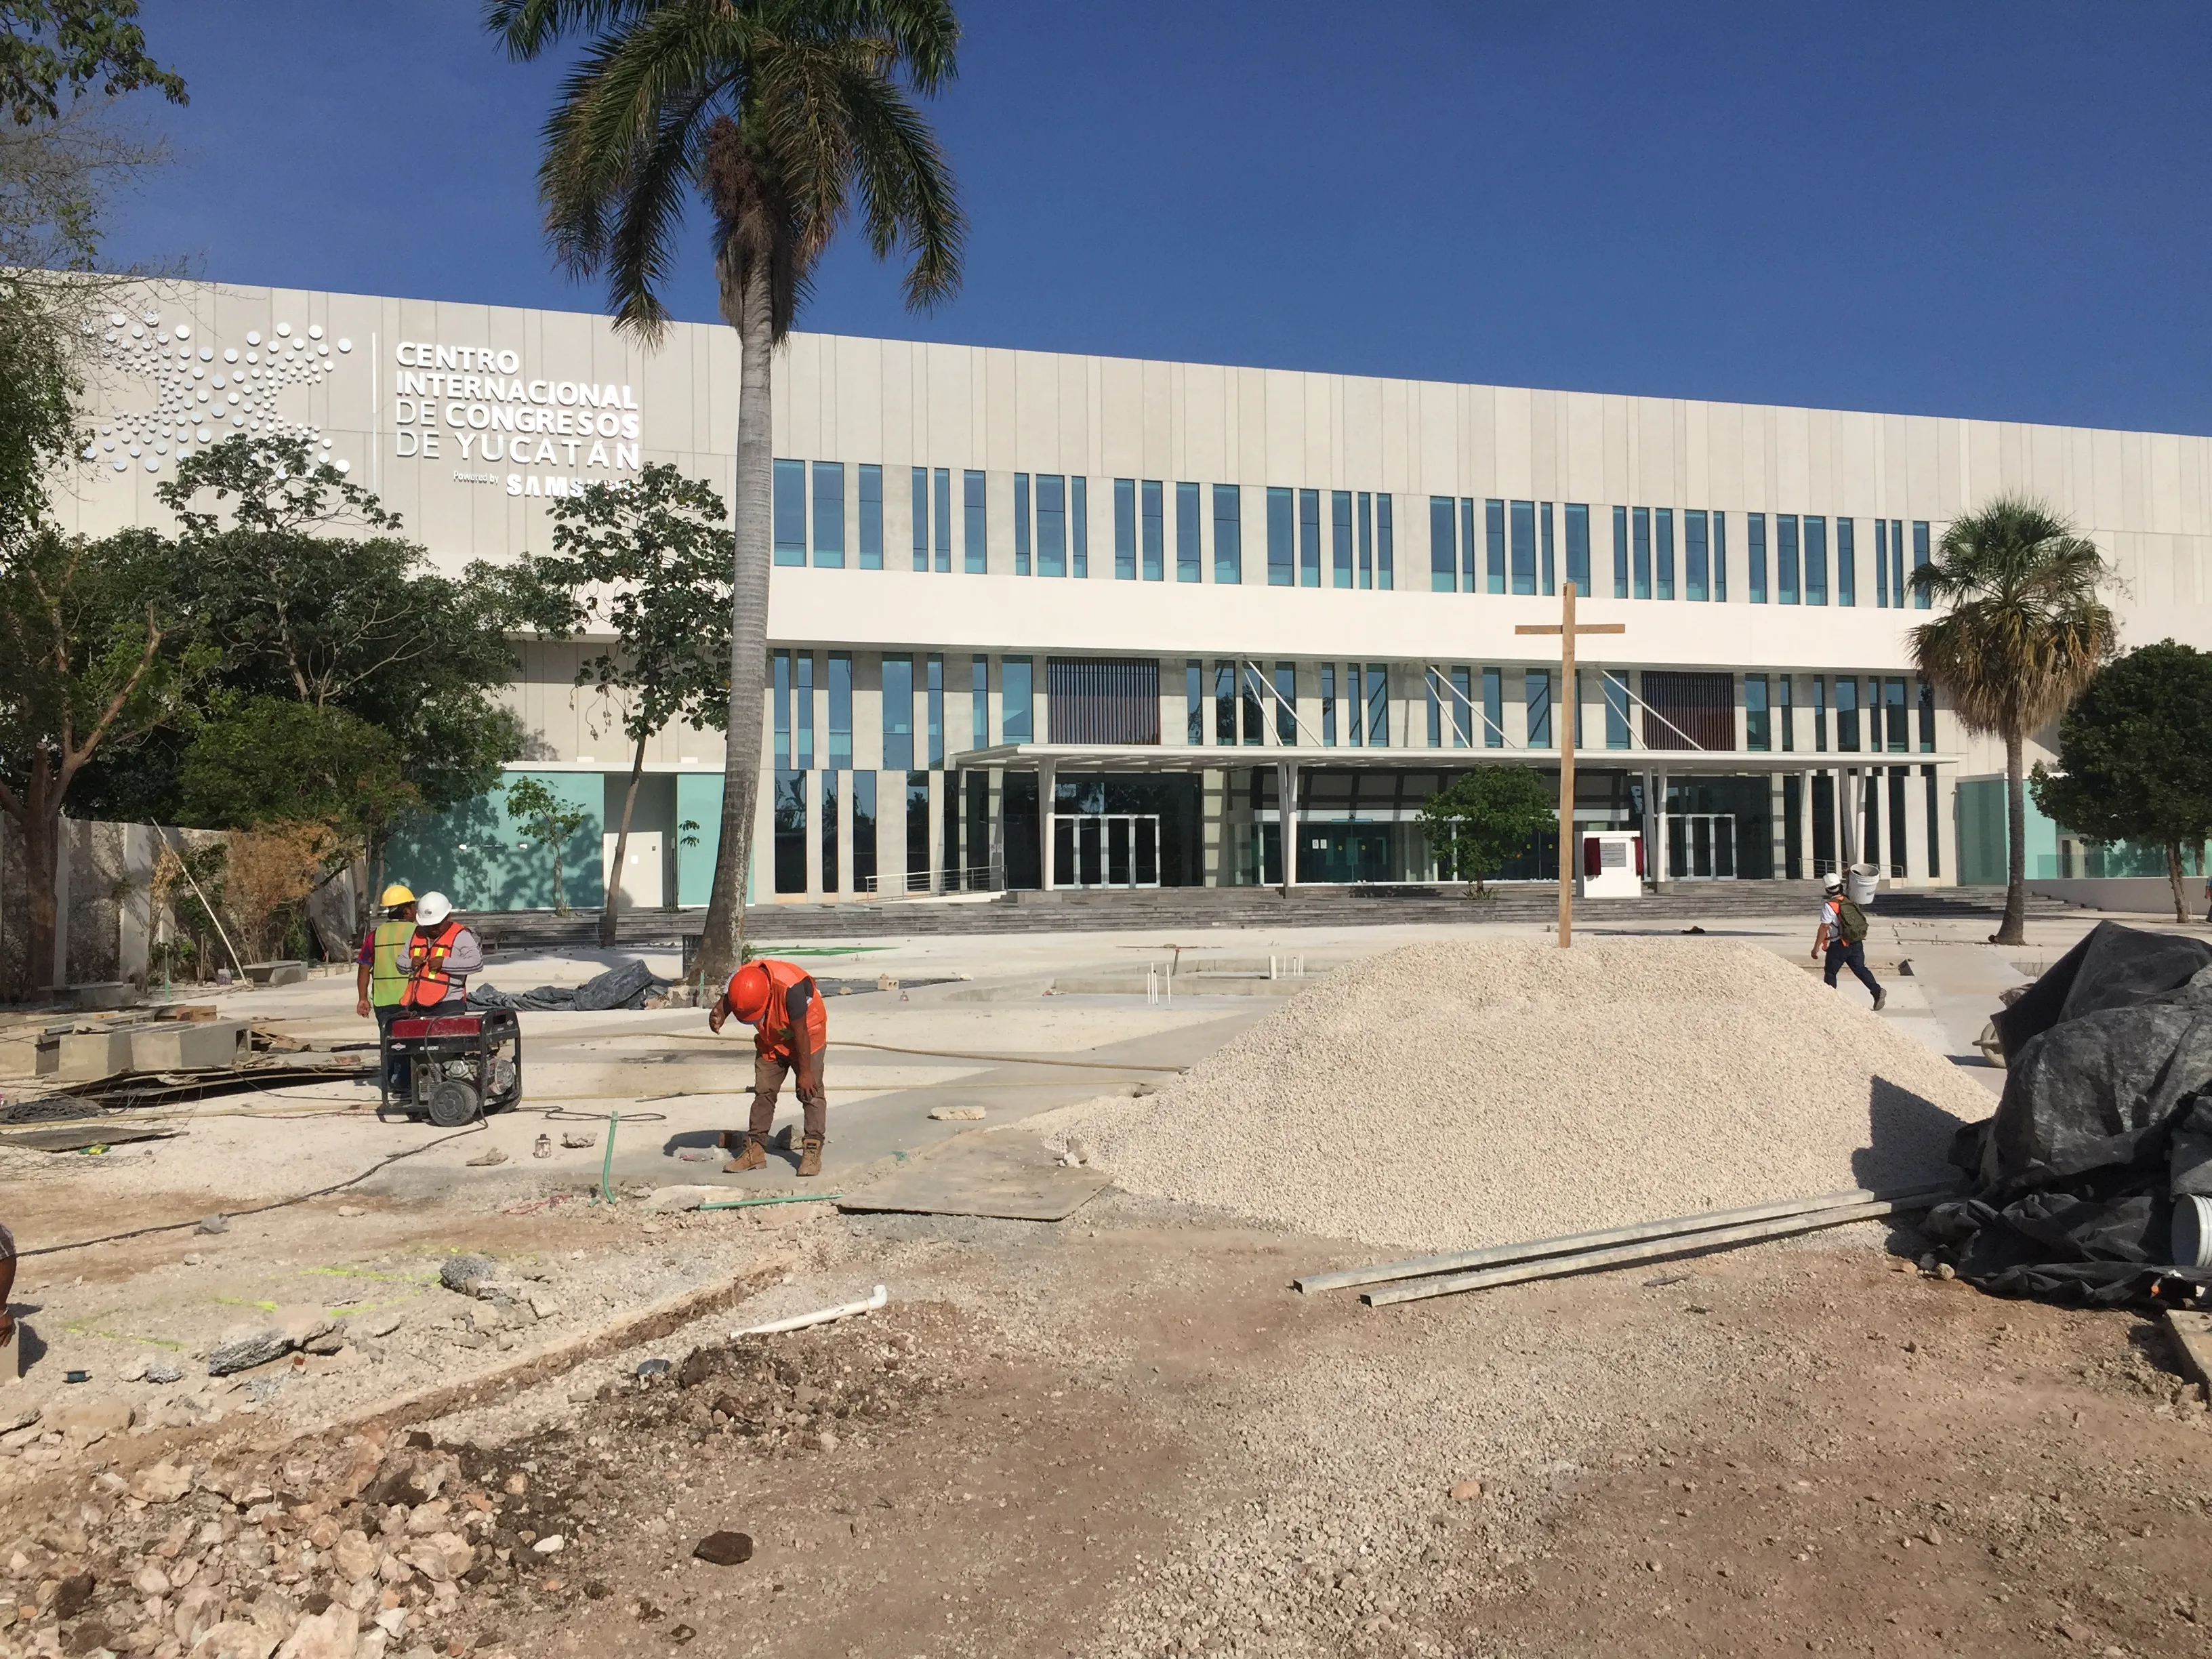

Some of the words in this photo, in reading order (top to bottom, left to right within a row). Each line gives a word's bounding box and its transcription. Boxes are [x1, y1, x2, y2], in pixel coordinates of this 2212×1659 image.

[396, 342, 520, 375] CENTRO
[396, 371, 638, 410] INTERNACIONAL
[396, 398, 436, 427] DE
[445, 402, 639, 440] CONGRESOS
[396, 429, 439, 459] DE
[454, 432, 639, 471] YUCATÁN
[453, 471, 487, 483] Powered
[489, 474, 499, 486] by
[507, 474, 639, 501] SAMS
